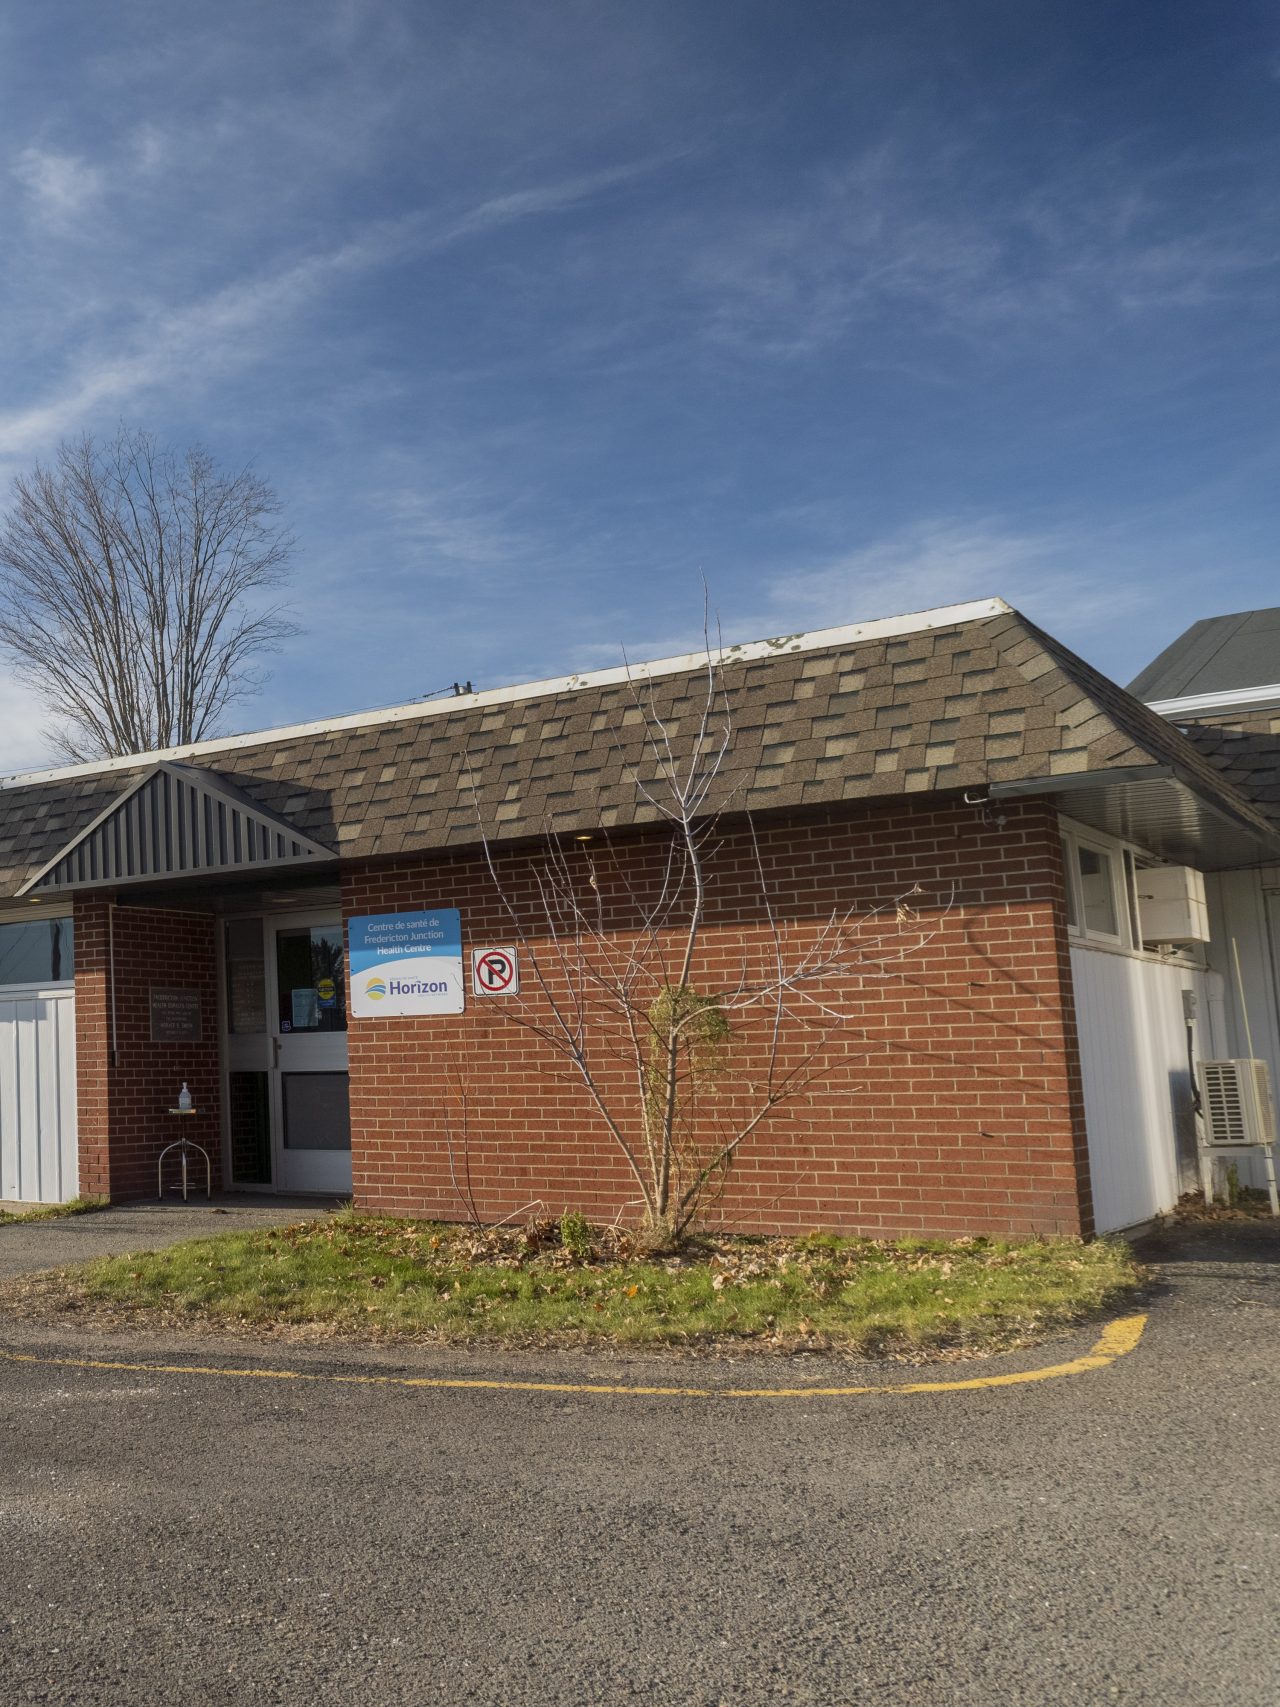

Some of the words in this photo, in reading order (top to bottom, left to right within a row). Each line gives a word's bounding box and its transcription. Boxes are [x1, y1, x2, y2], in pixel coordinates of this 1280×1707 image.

[368, 923, 394, 932] Centre
[395, 921, 405, 930] de
[407, 918, 428, 929] santé
[429, 917, 440, 927] de
[364, 934, 408, 944] Fredericton
[411, 931, 444, 941] Junction
[377, 945, 403, 955] Health
[404, 944, 432, 953] Centre
[390, 980, 448, 995] Horizon
